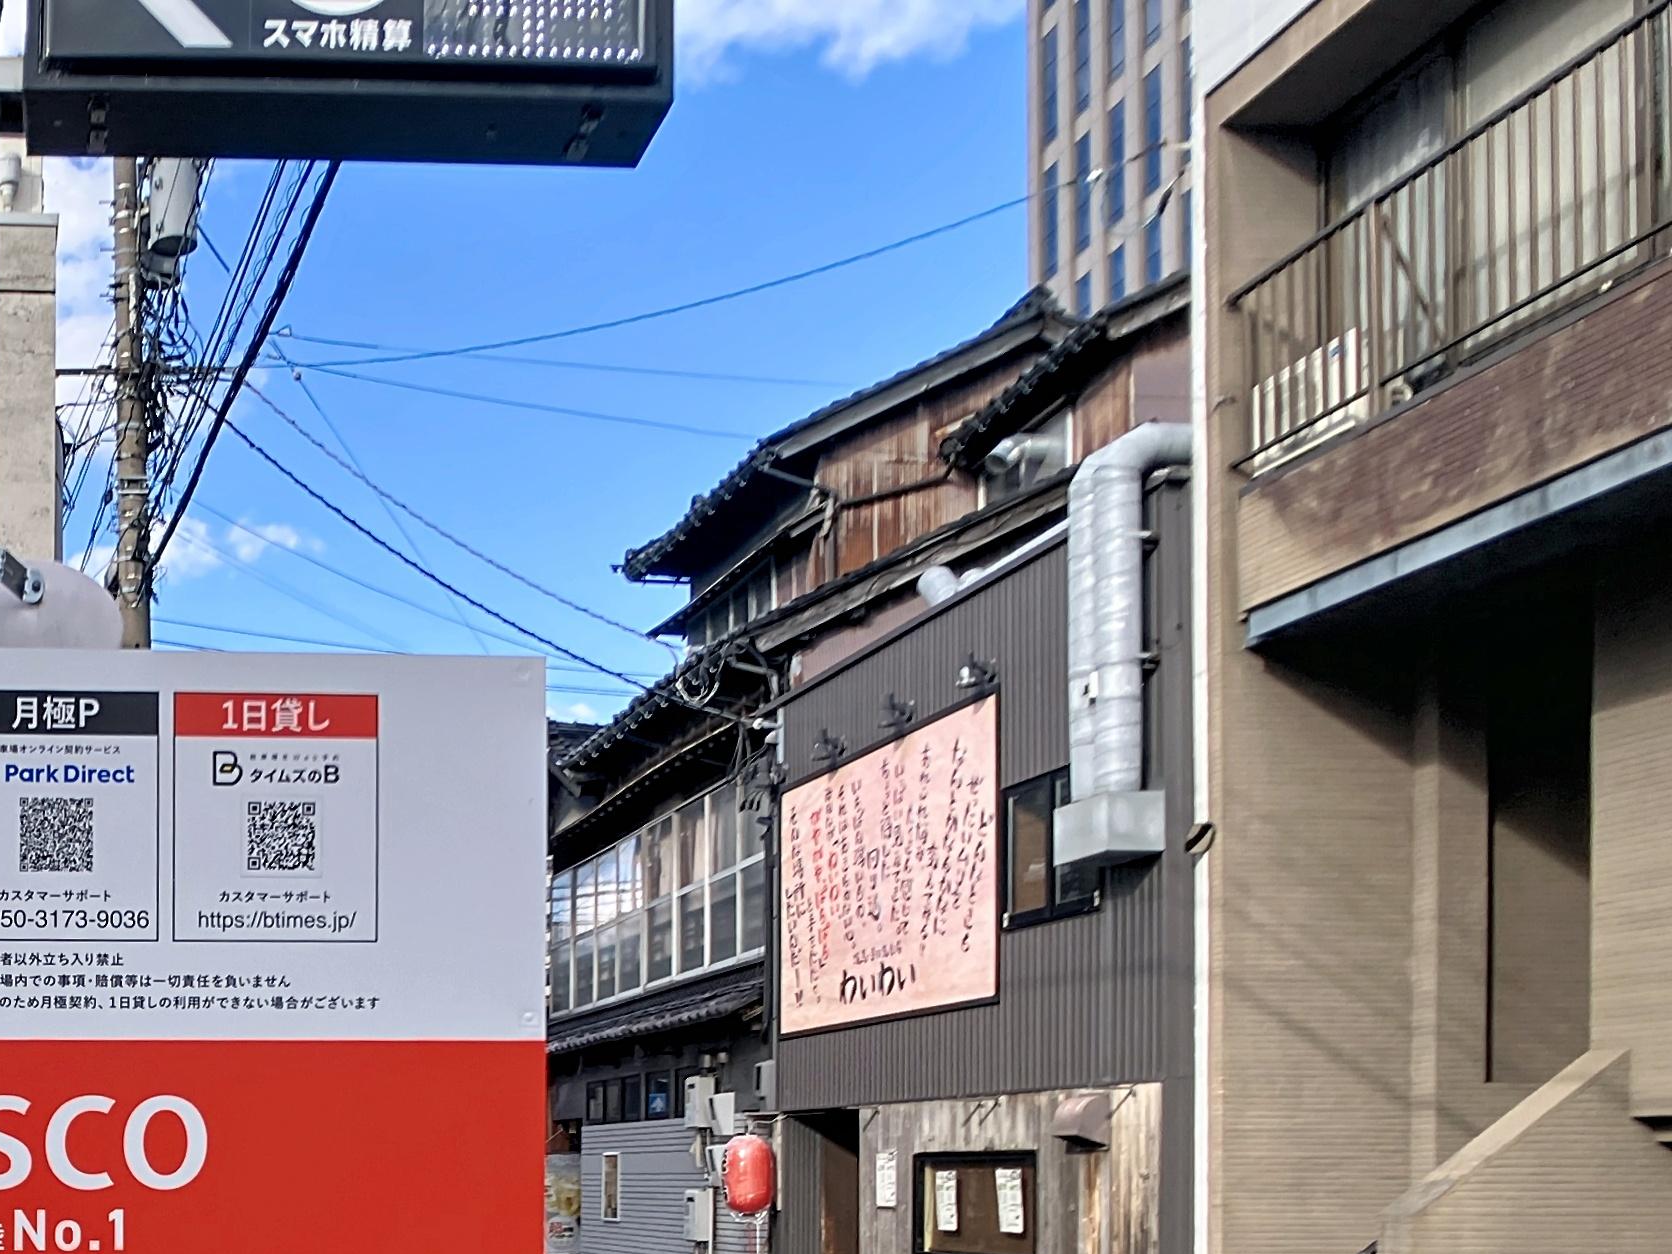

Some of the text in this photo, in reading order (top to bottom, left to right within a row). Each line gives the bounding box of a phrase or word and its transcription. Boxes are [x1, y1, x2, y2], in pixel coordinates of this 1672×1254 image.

[264, 18, 412, 51] スマホ精算
[12, 696, 99, 729] 月極P
[223, 699, 329, 732] 1日貸し
[5, 764, 134, 783] Park Direct
[251, 765, 339, 783] タイムズのB
[0, 890, 111, 902] カスタマーサポート
[219, 891, 330, 903] カスタマーサポート
[199, 911, 357, 933] https://btimes.jp/
[839, 963, 917, 1005] わいわい
